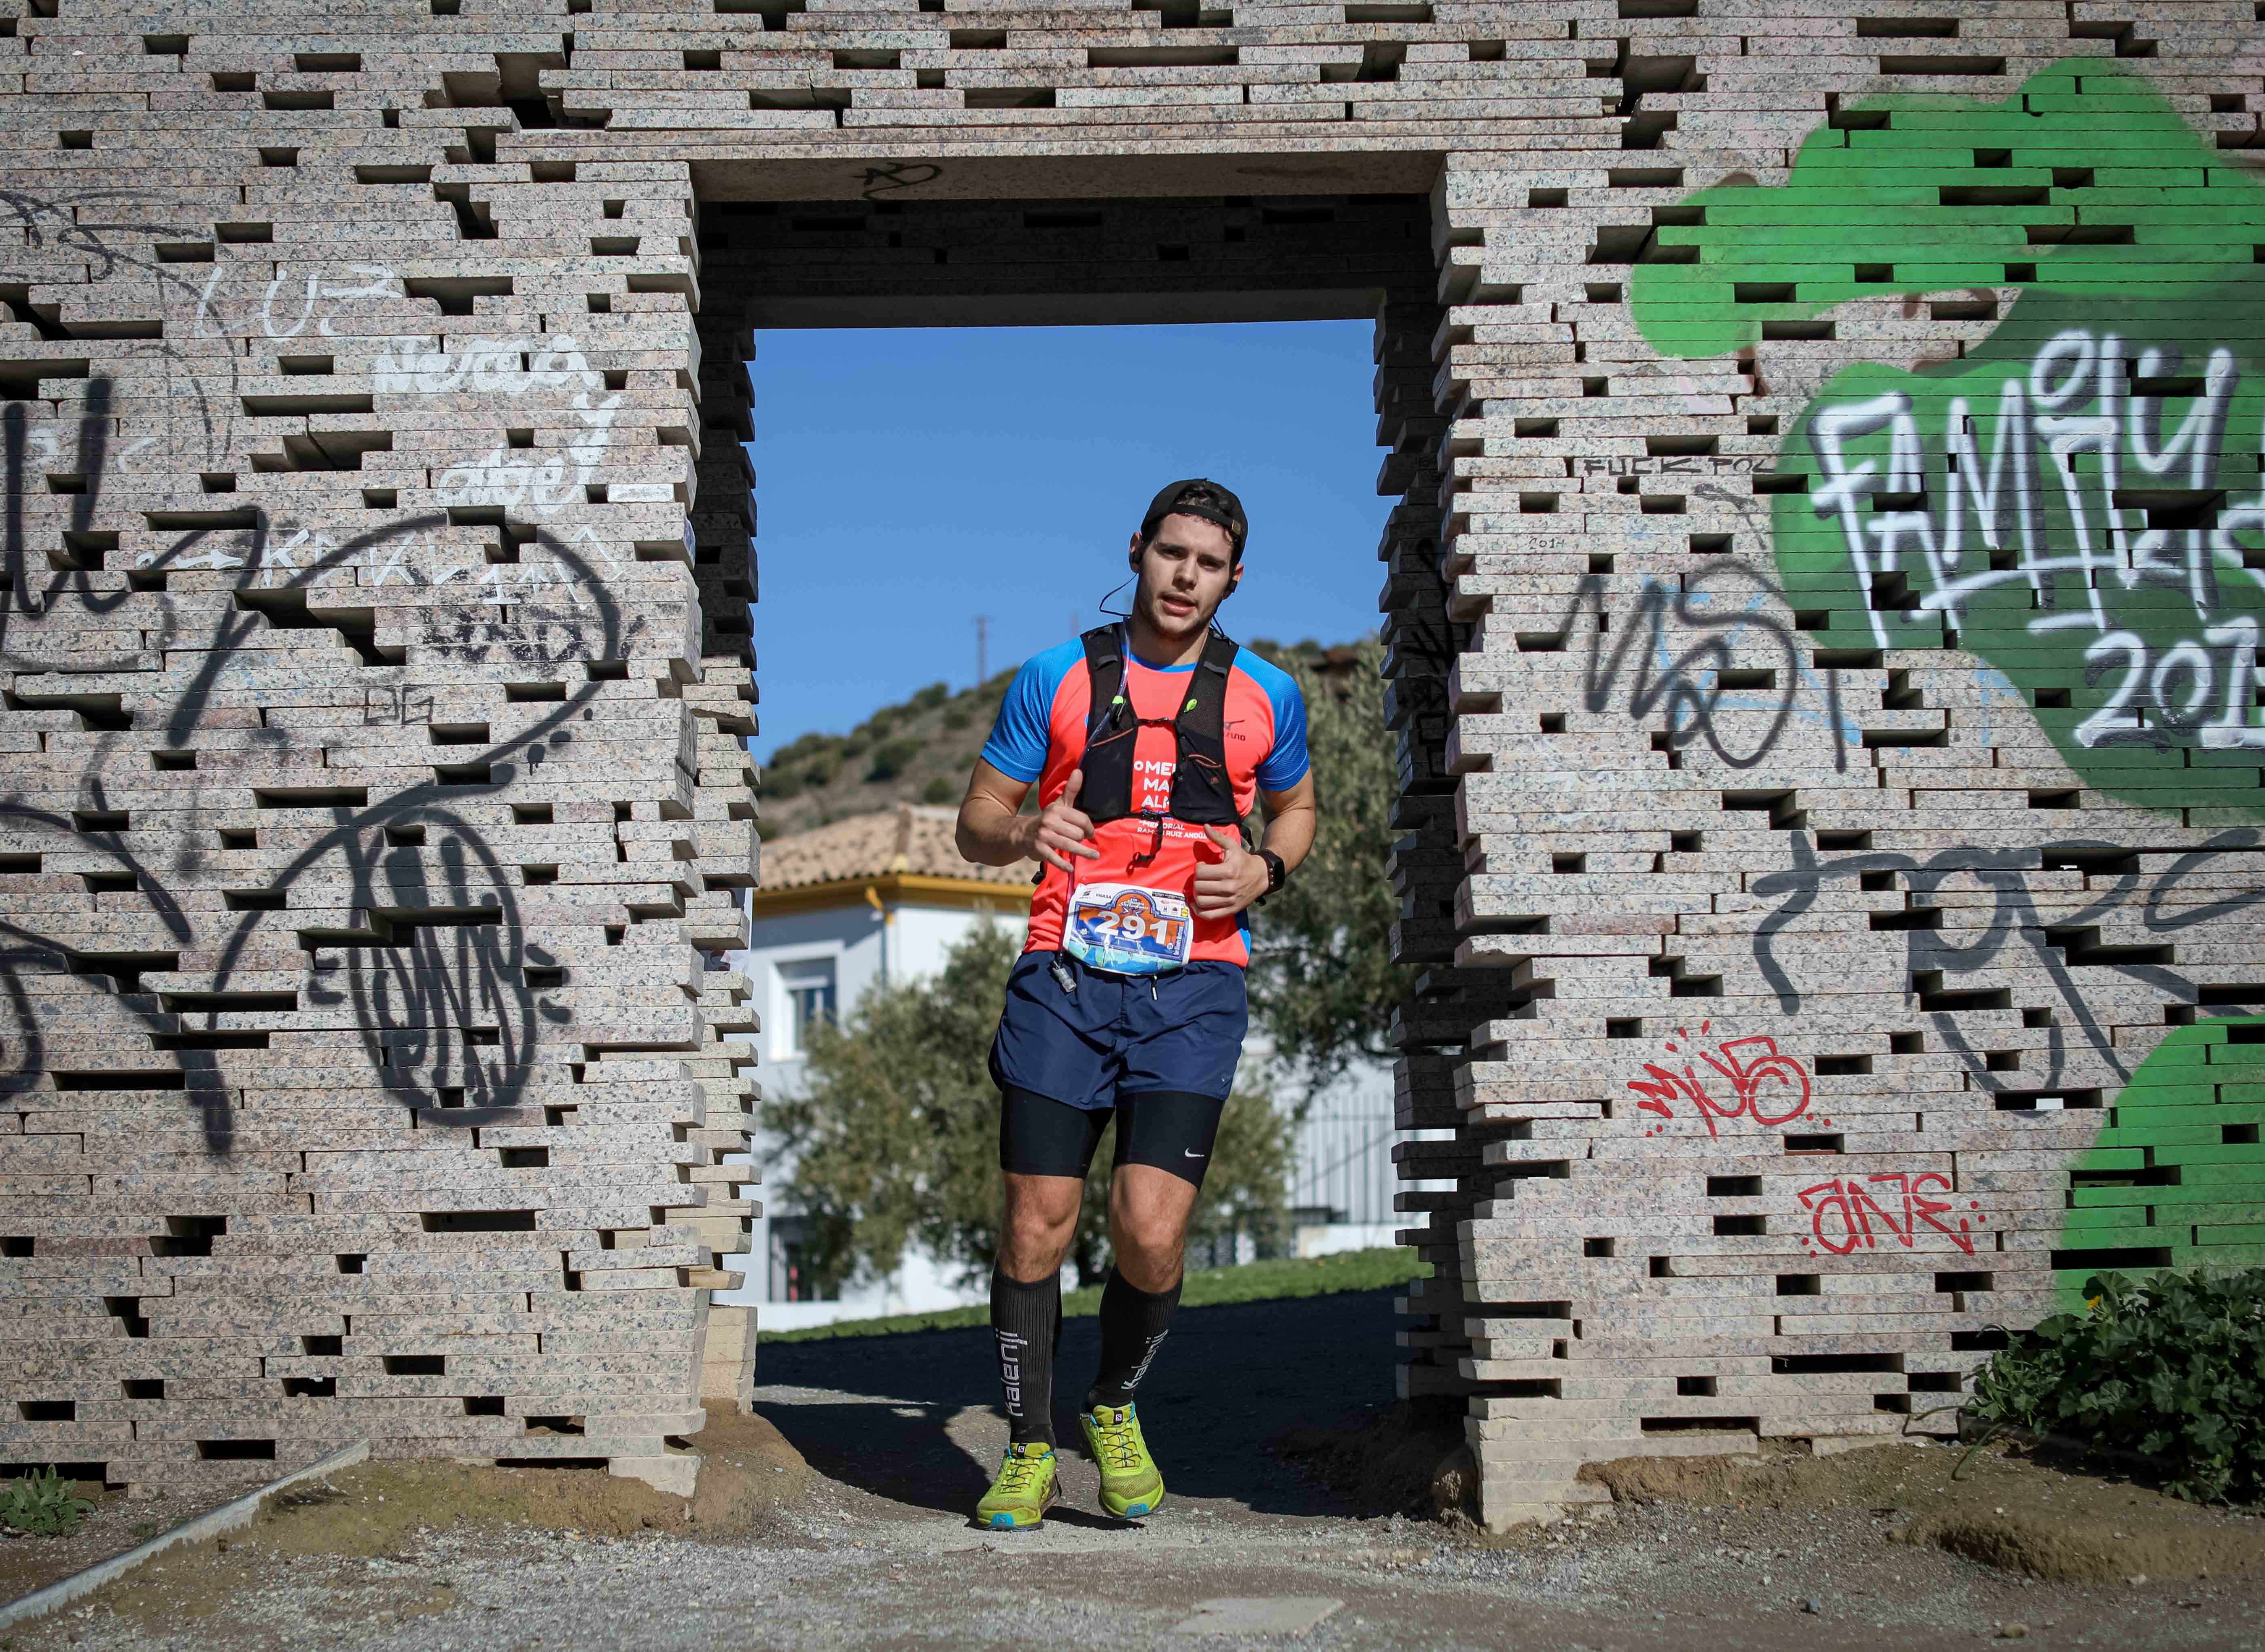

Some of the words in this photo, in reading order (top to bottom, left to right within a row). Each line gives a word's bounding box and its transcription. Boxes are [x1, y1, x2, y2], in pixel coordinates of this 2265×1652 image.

[1583, 457, 1702, 477] FUCK
[2074, 617, 2265, 748] 201
[1094, 911, 1168, 945] 291
